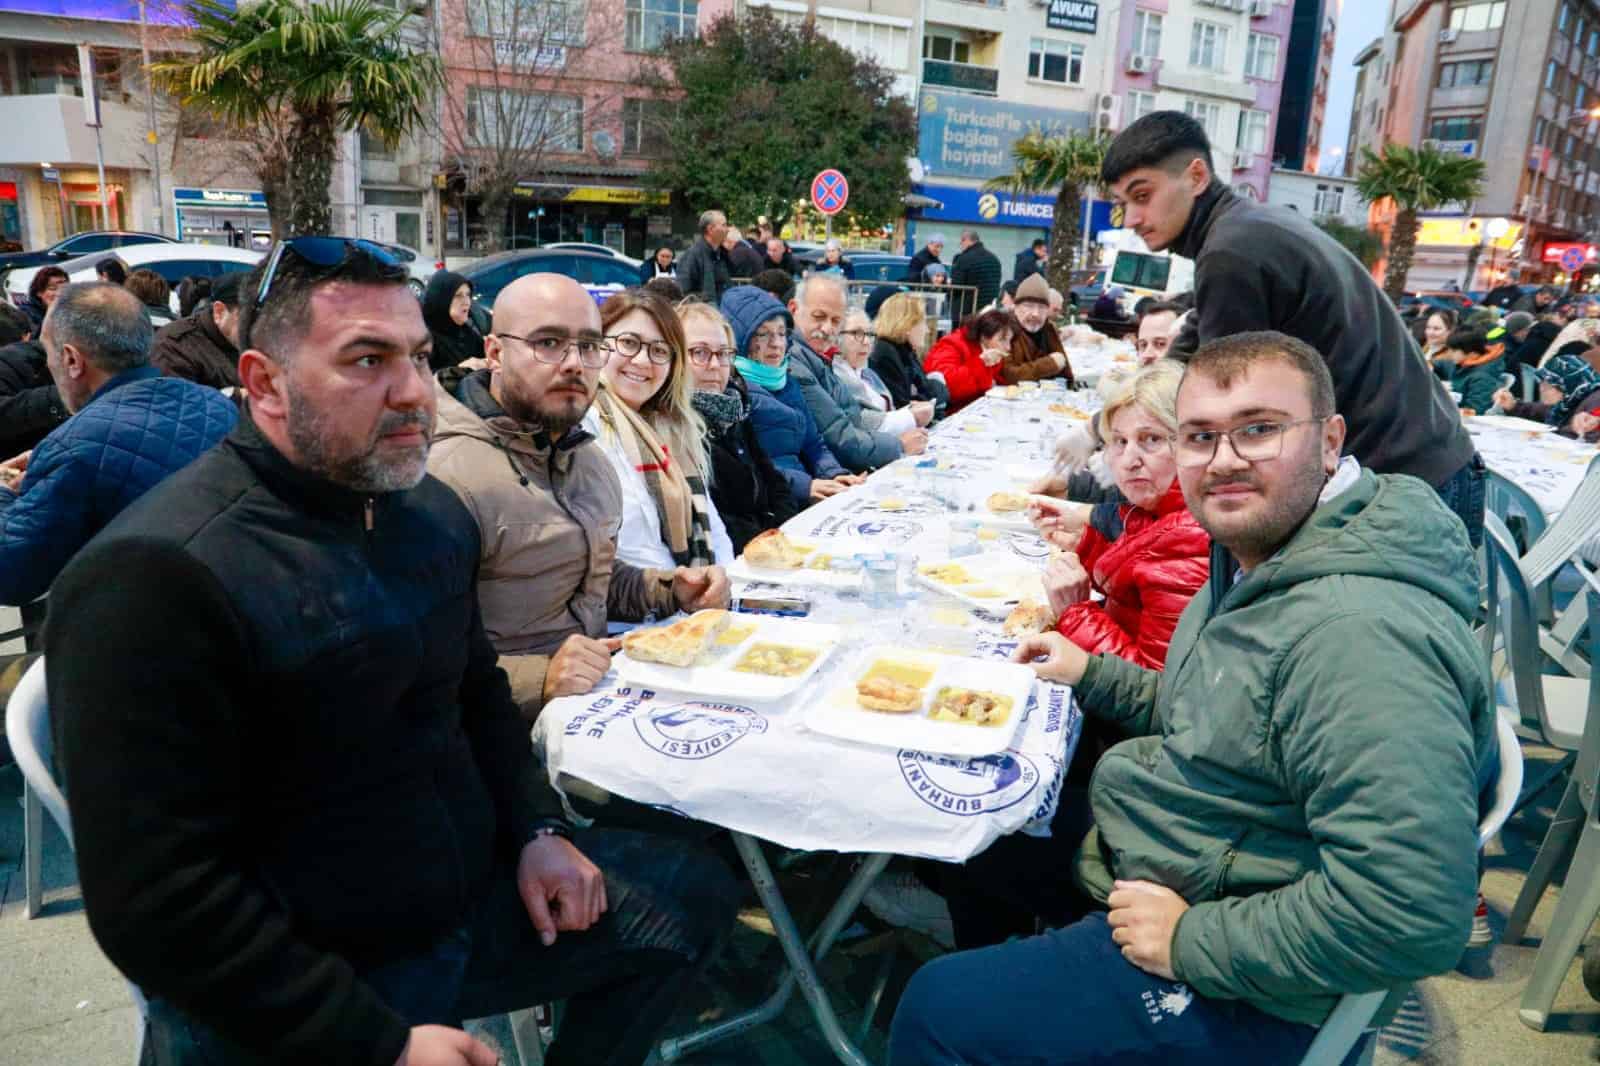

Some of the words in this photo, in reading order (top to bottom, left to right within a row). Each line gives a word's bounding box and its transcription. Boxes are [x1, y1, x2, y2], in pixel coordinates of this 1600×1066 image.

[1051, 0, 1097, 19] AVUKAT
[943, 124, 999, 149] bağlan
[1001, 201, 1054, 219] TURKCEL
